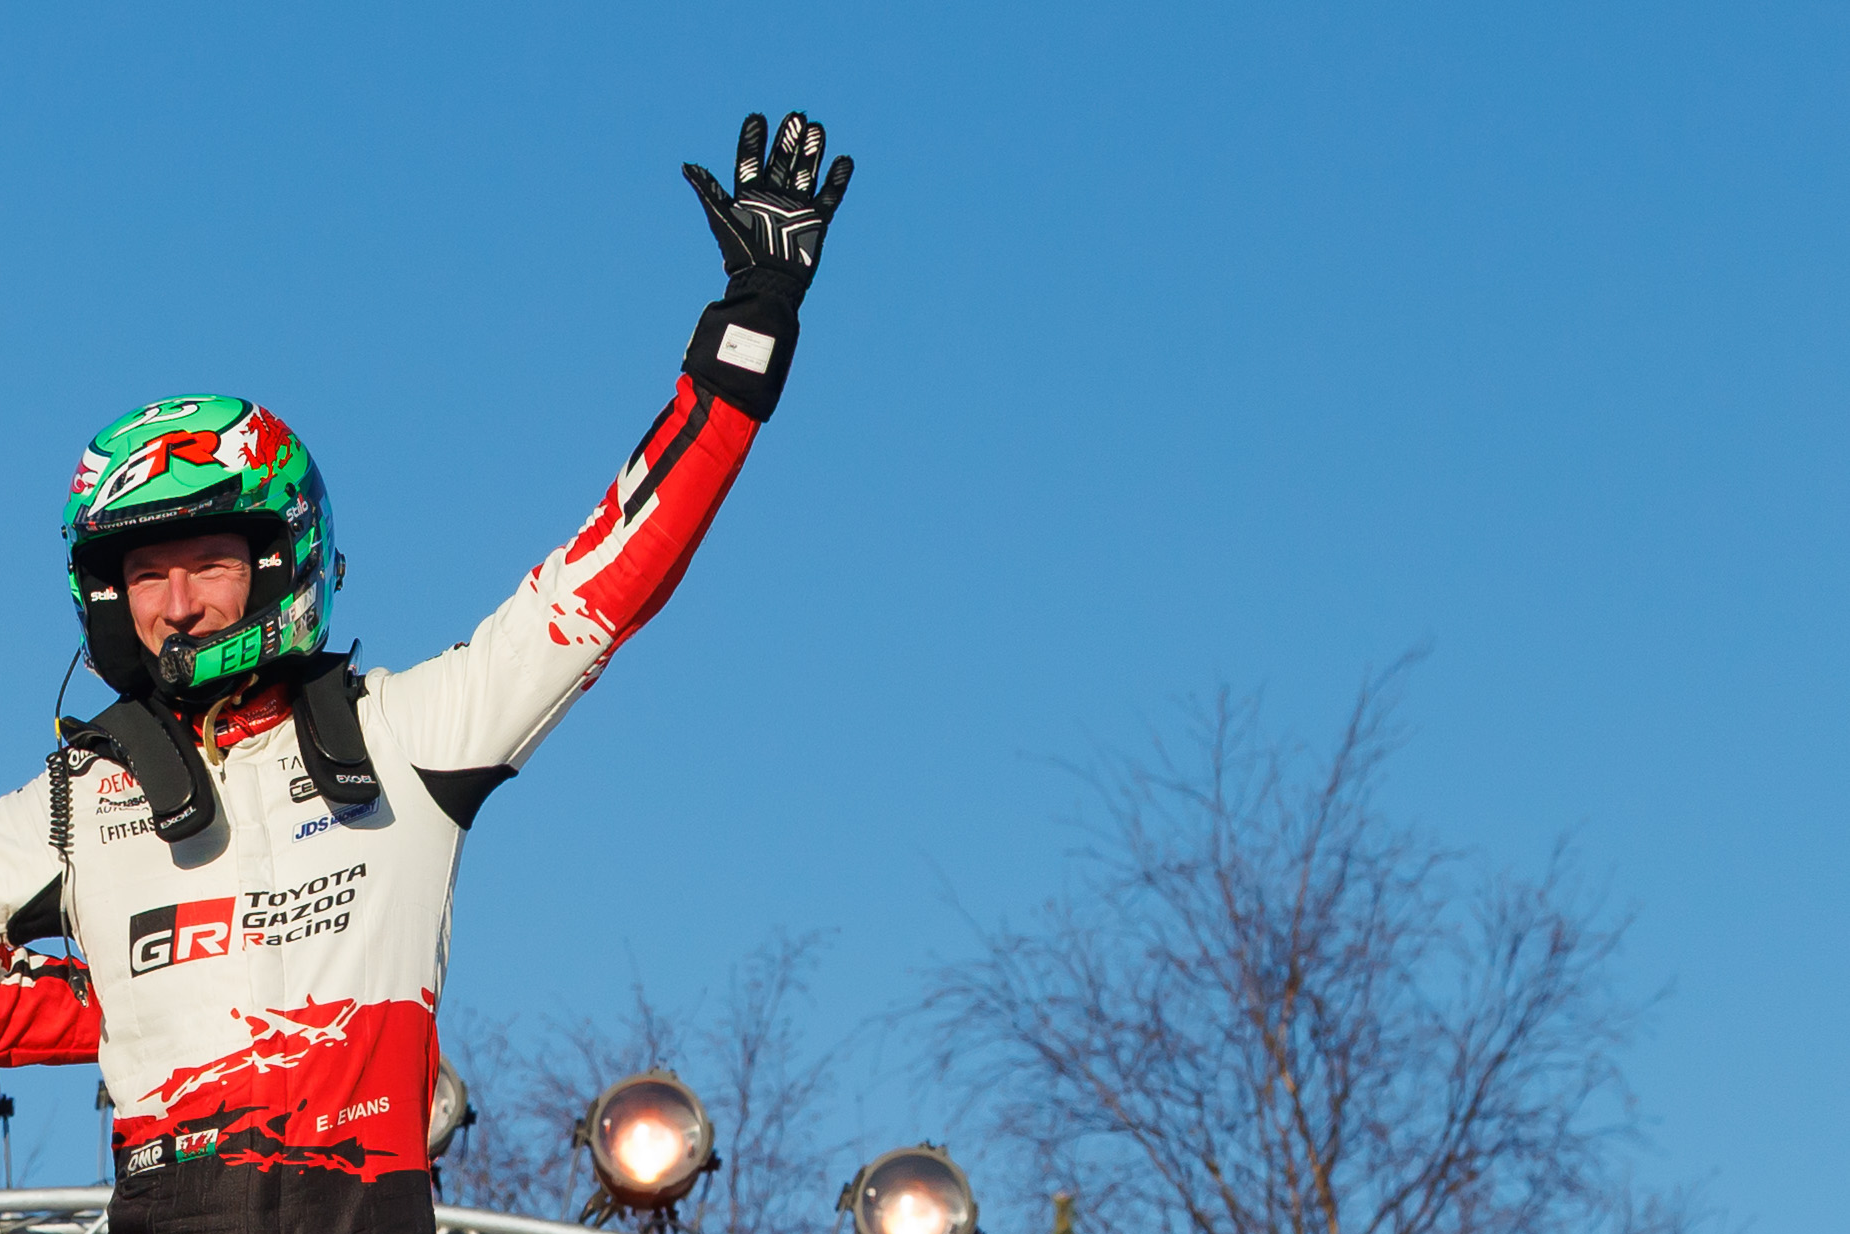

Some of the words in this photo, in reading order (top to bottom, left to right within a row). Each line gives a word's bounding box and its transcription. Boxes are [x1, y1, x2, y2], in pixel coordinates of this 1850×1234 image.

[87, 430, 230, 517] GR
[99, 519, 137, 530] TOYOTA
[138, 510, 177, 523] GAZOO
[295, 816, 329, 840] JDS
[244, 863, 366, 908] TOYOTA
[243, 889, 355, 929] GAZOO
[132, 922, 229, 972] GR
[242, 911, 350, 951] Racing
[316, 1115, 334, 1133] E.
[337, 1096, 390, 1126] EVANS
[127, 1145, 163, 1172] OMP
